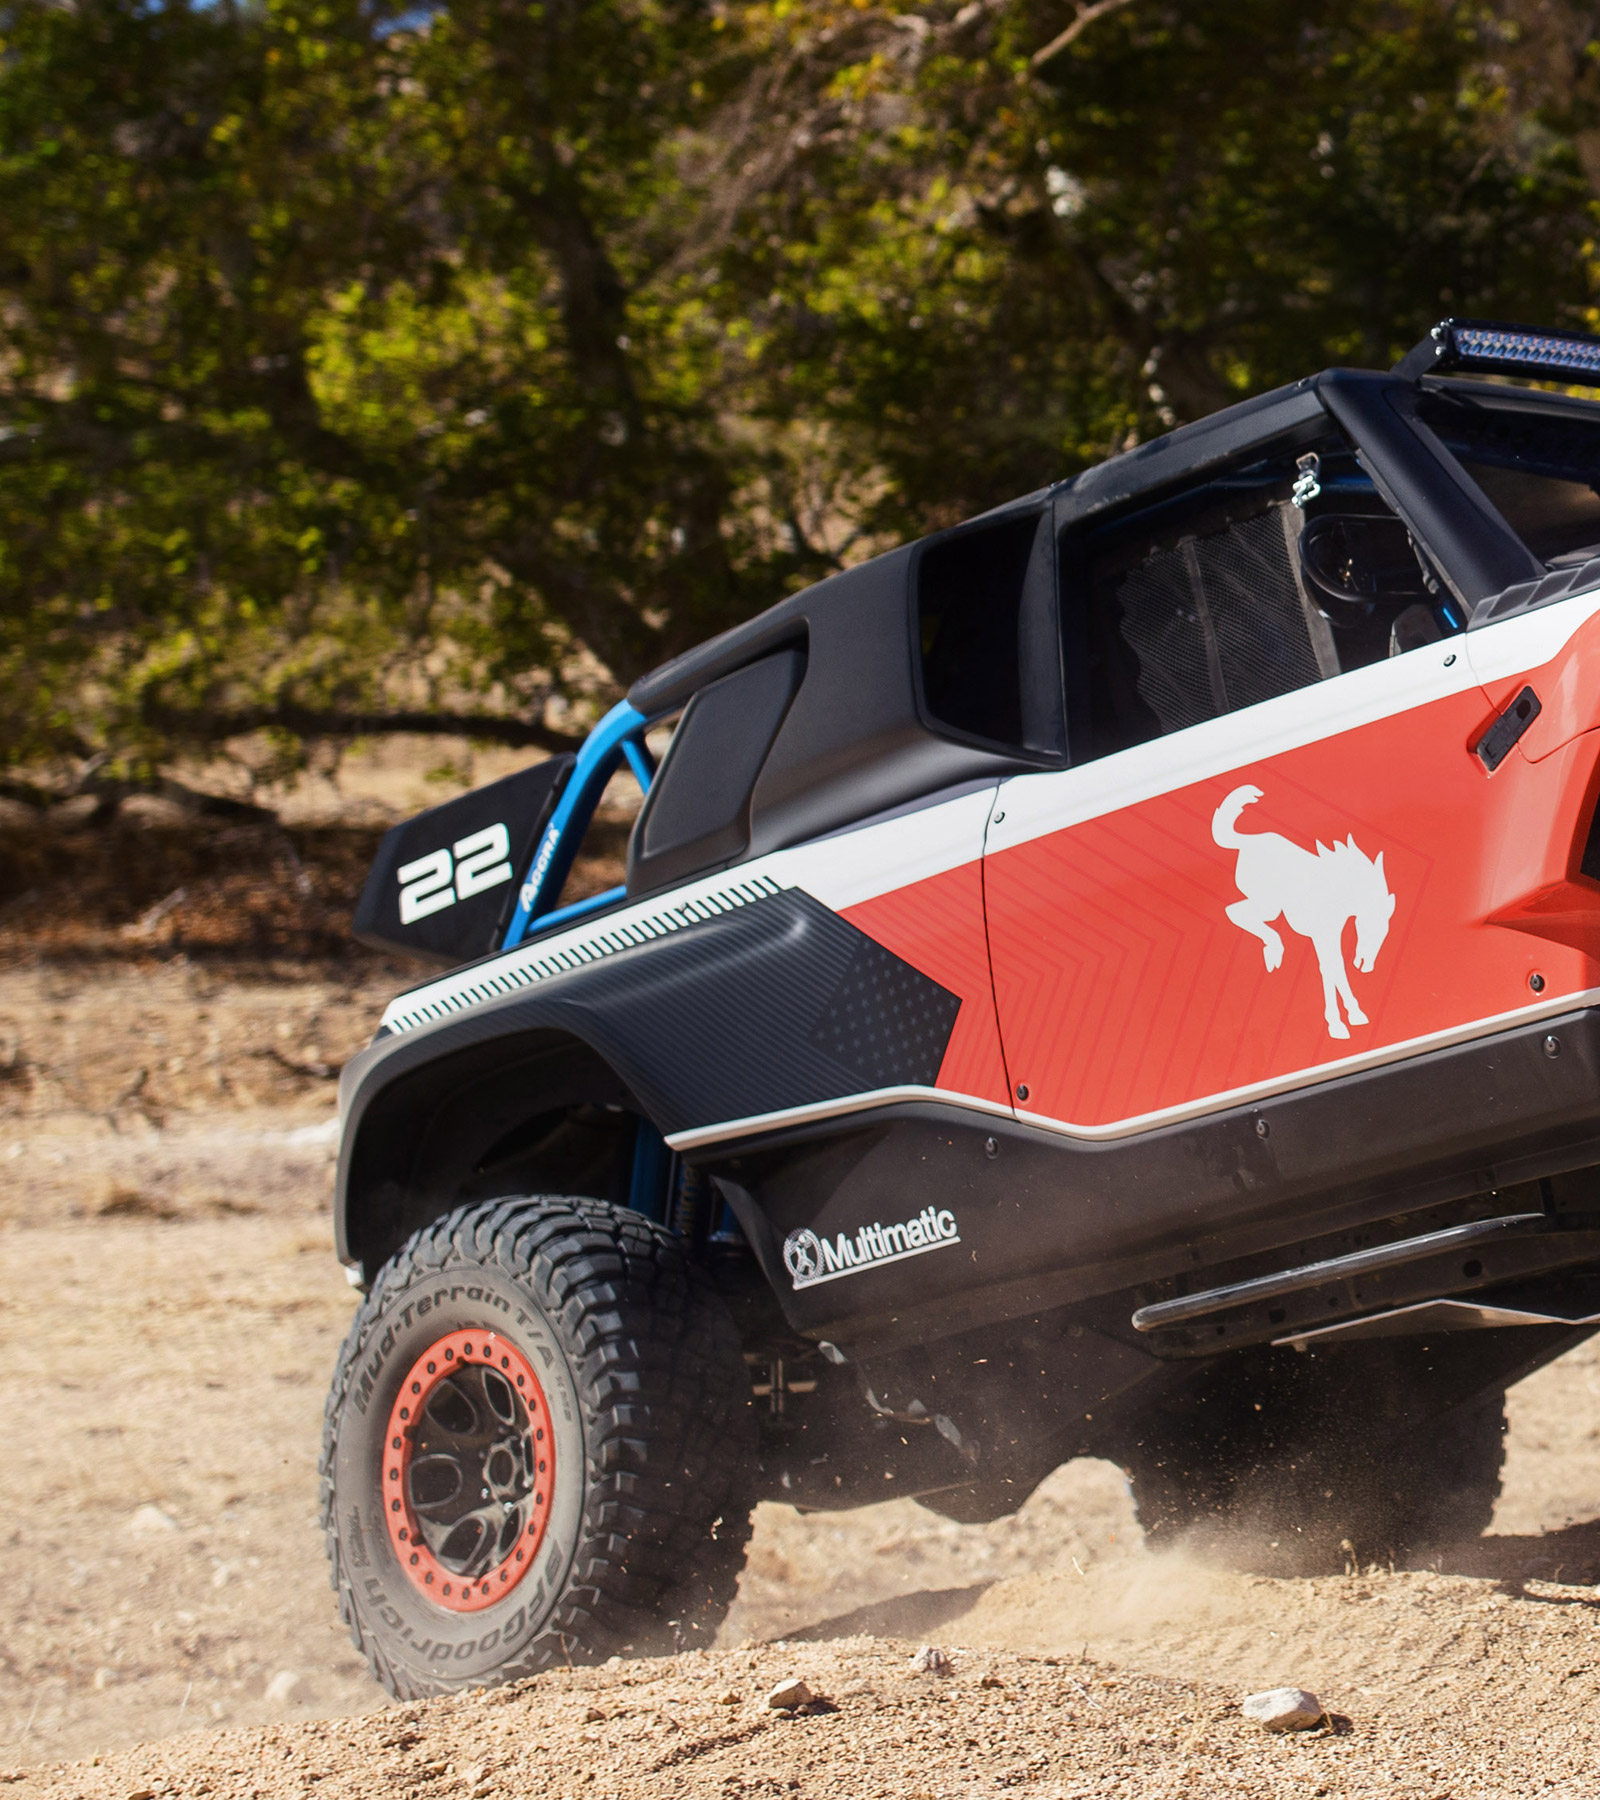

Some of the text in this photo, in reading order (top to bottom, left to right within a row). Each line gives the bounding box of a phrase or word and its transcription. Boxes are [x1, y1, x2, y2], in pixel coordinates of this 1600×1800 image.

[398, 823, 513, 925] 22
[821, 1206, 958, 1272] Multimatic
[354, 1284, 510, 1415] Mud-Terrain
[516, 1308, 554, 1369] T/A
[364, 1540, 564, 1662] BFGoodrich
